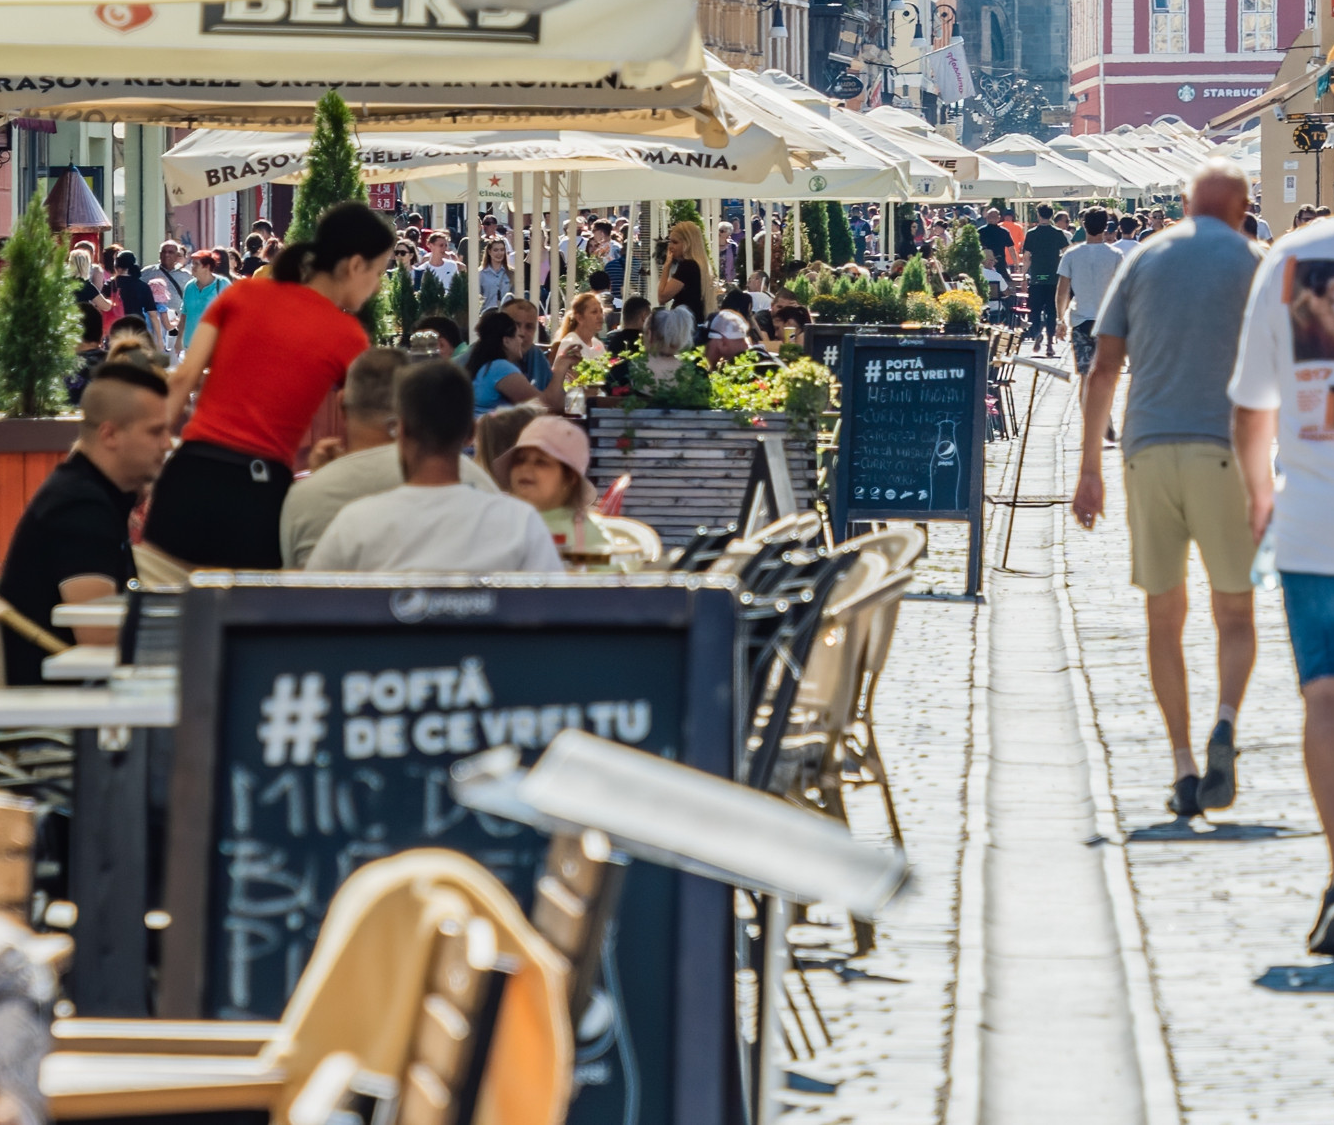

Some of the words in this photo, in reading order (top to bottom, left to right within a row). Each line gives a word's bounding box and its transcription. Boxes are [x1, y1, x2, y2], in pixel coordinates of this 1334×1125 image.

[1203, 88, 1266, 98] STARBUCK
[478, 190, 513, 199] eineke
[886, 372, 902, 382] DE
[904, 371, 920, 381] CE
[922, 370, 948, 380] VREI
[950, 369, 965, 379] TU
[344, 715, 407, 760] DE
[412, 712, 479, 757] CE
[587, 700, 651, 742] TU
